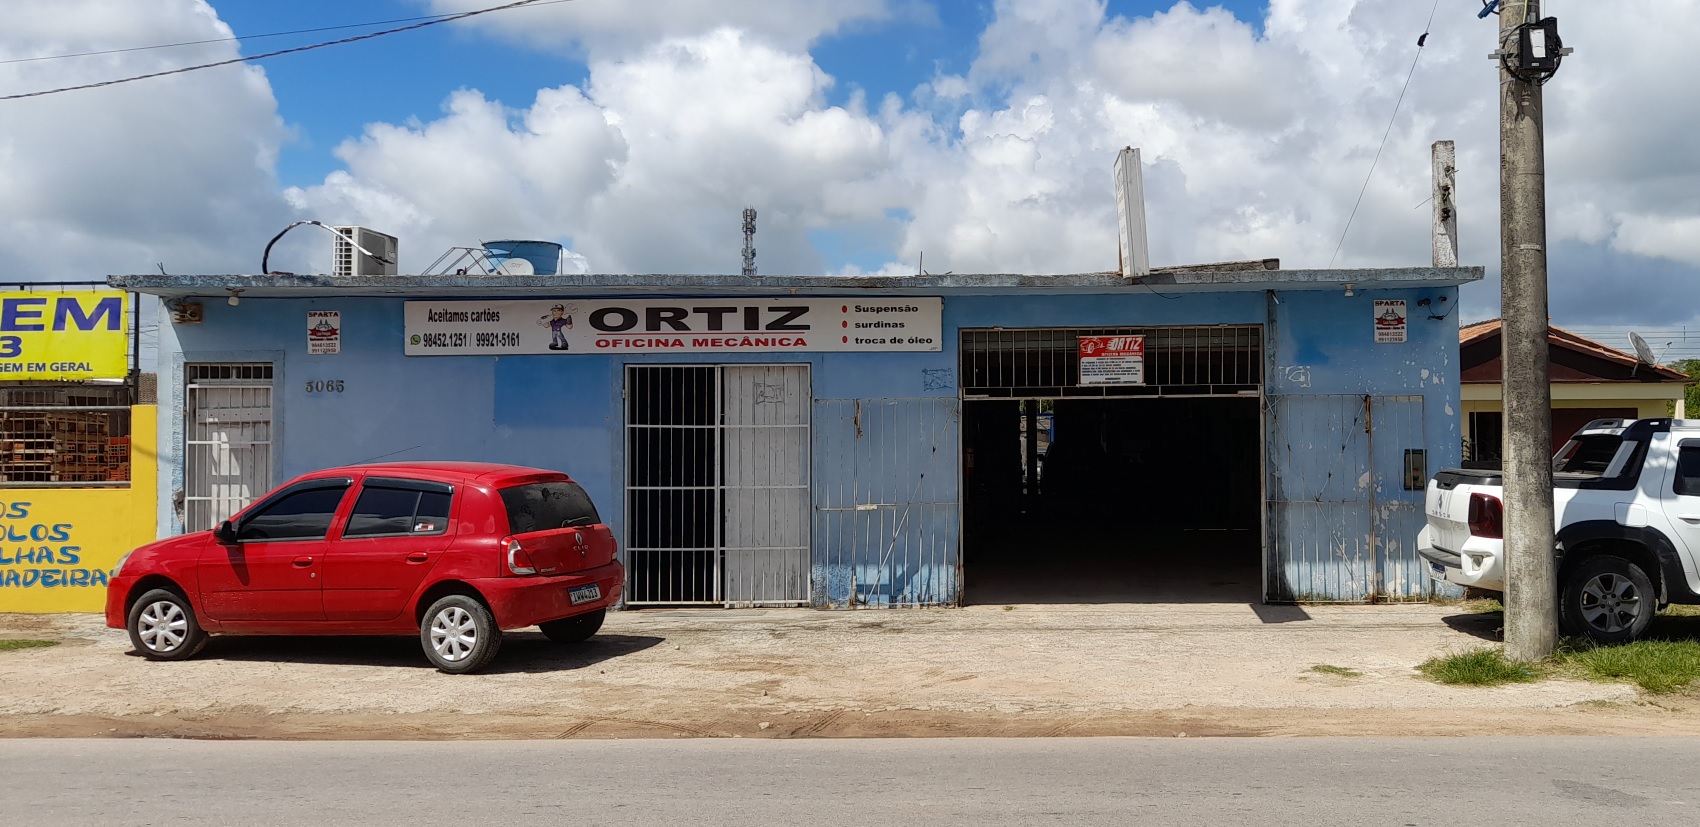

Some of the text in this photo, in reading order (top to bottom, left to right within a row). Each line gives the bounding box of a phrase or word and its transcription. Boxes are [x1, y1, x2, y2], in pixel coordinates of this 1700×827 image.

[1, 297, 122, 331] EM
[428, 308, 500, 322] Aceitamos cartões
[854, 304, 919, 314] Suspensão
[588, 306, 811, 332] ORTIZ
[854, 321, 905, 329] surdinas
[423, 333, 467, 347] 98452.1251
[476, 332, 520, 347] 99921-5161
[595, 336, 808, 348] OFICINA MECÂNICA
[908, 336, 933, 344] óleo
[0, 335, 23, 358] 3
[27, 362, 46, 372] EM
[50, 362, 93, 372] GERAL
